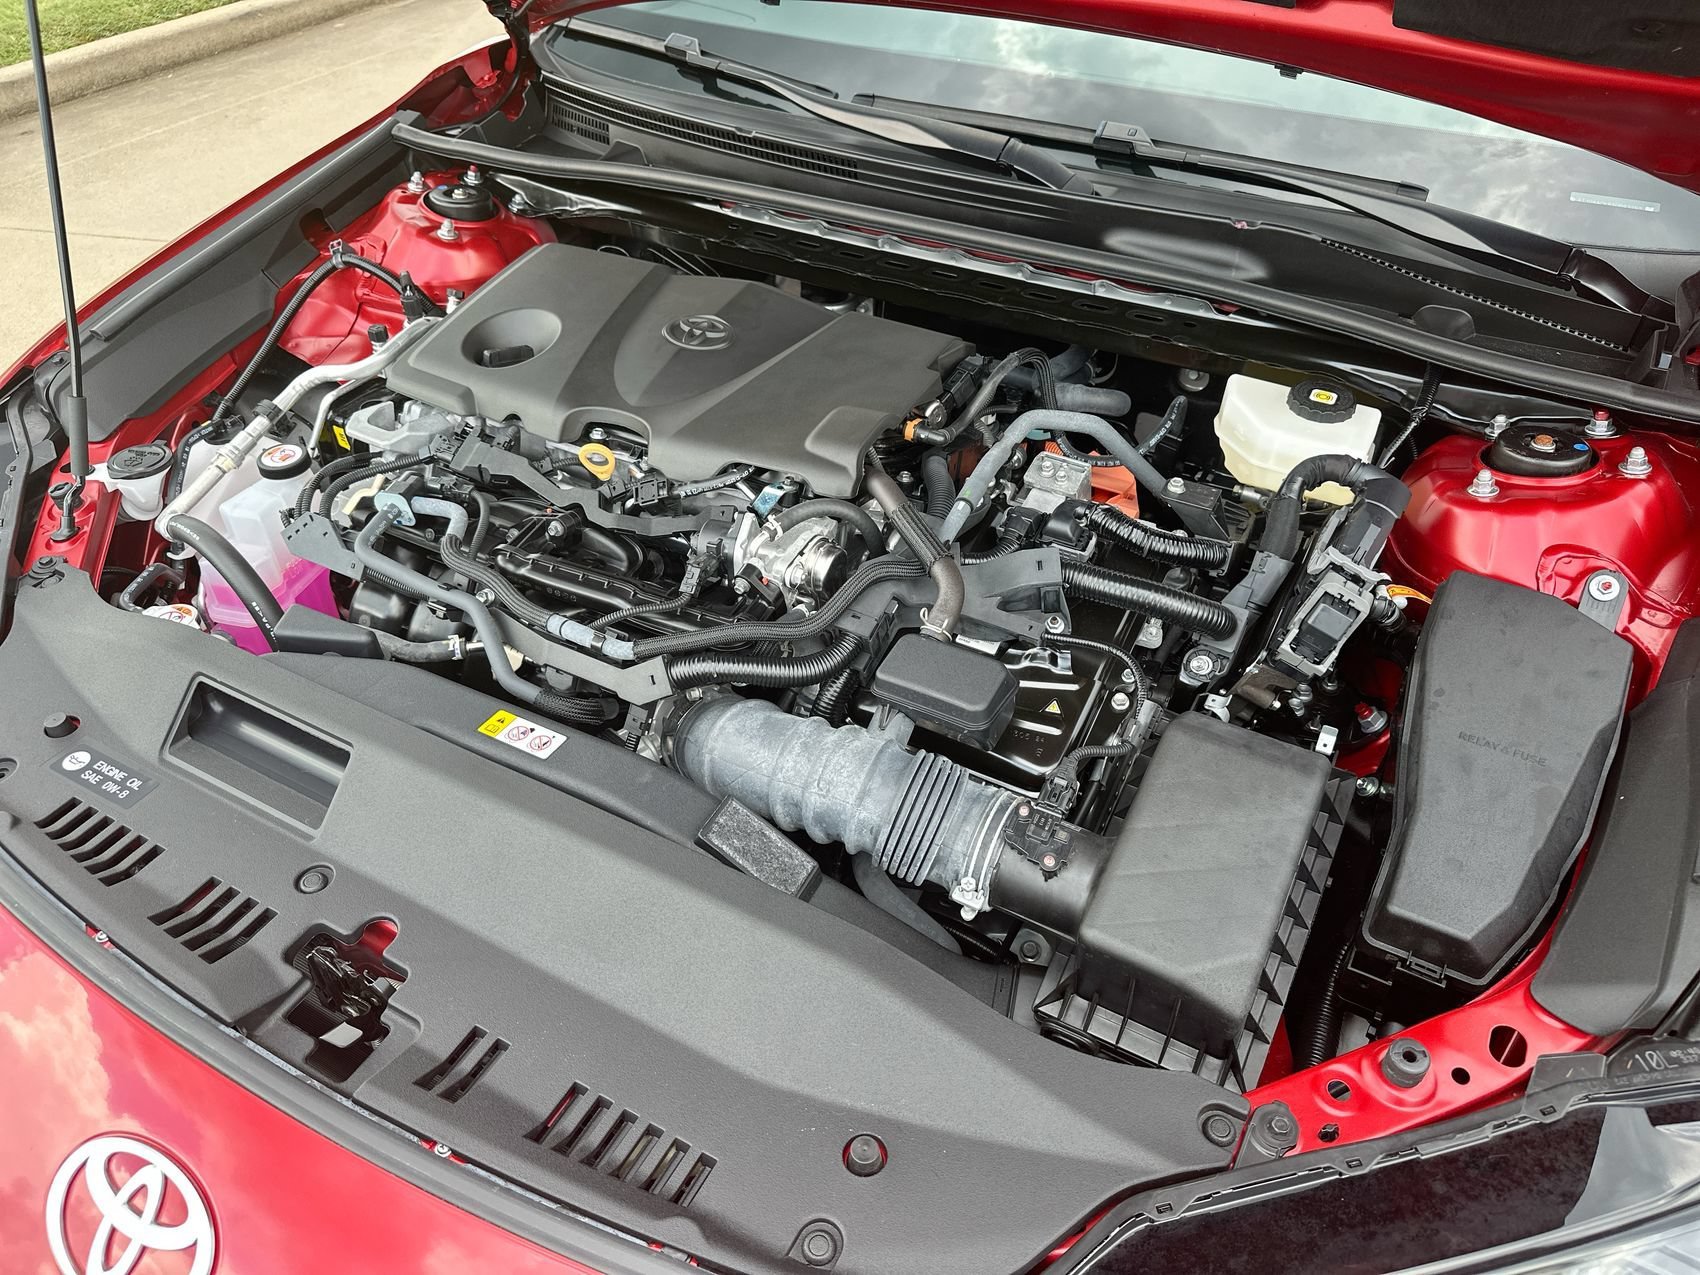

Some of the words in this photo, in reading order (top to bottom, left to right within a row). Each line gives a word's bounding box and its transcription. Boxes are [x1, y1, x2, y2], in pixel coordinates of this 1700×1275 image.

[1458, 731, 1501, 751] RELAY
[1512, 749, 1548, 768] FUSE
[80, 769, 104, 785] SAE
[101, 781, 130, 799] 0W-8
[93, 760, 128, 781] ENGINE
[126, 777, 143, 791] OIL
